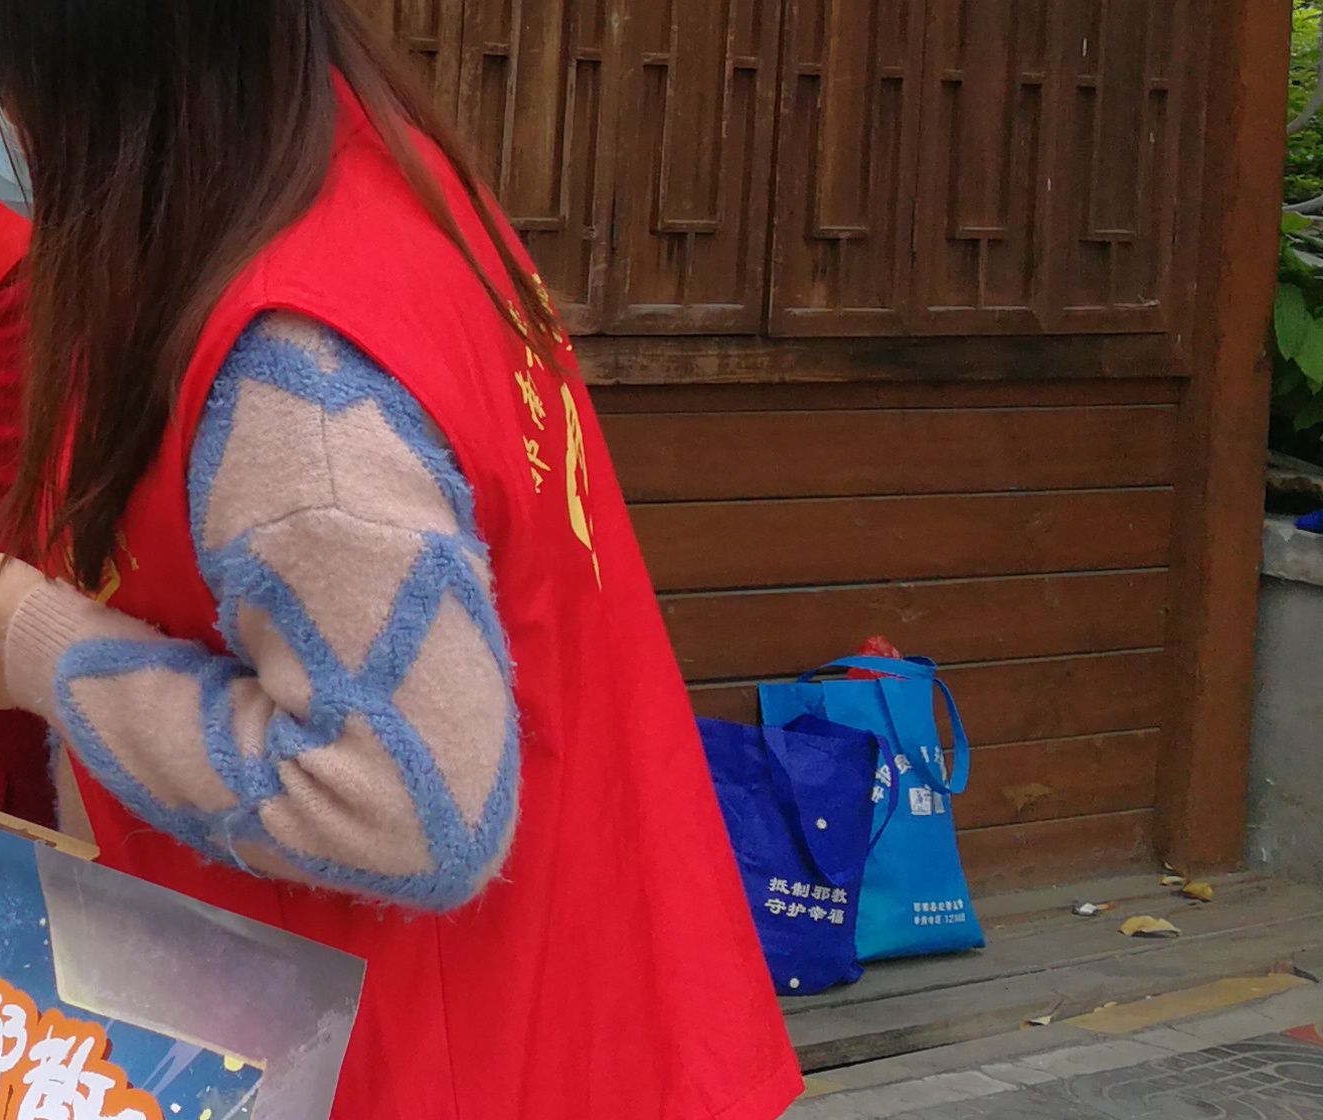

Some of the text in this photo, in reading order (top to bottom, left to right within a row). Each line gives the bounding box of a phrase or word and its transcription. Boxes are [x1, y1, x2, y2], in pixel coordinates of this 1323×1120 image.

[768, 877, 848, 904] 抵制邪教
[764, 898, 845, 925] 守护幸福
